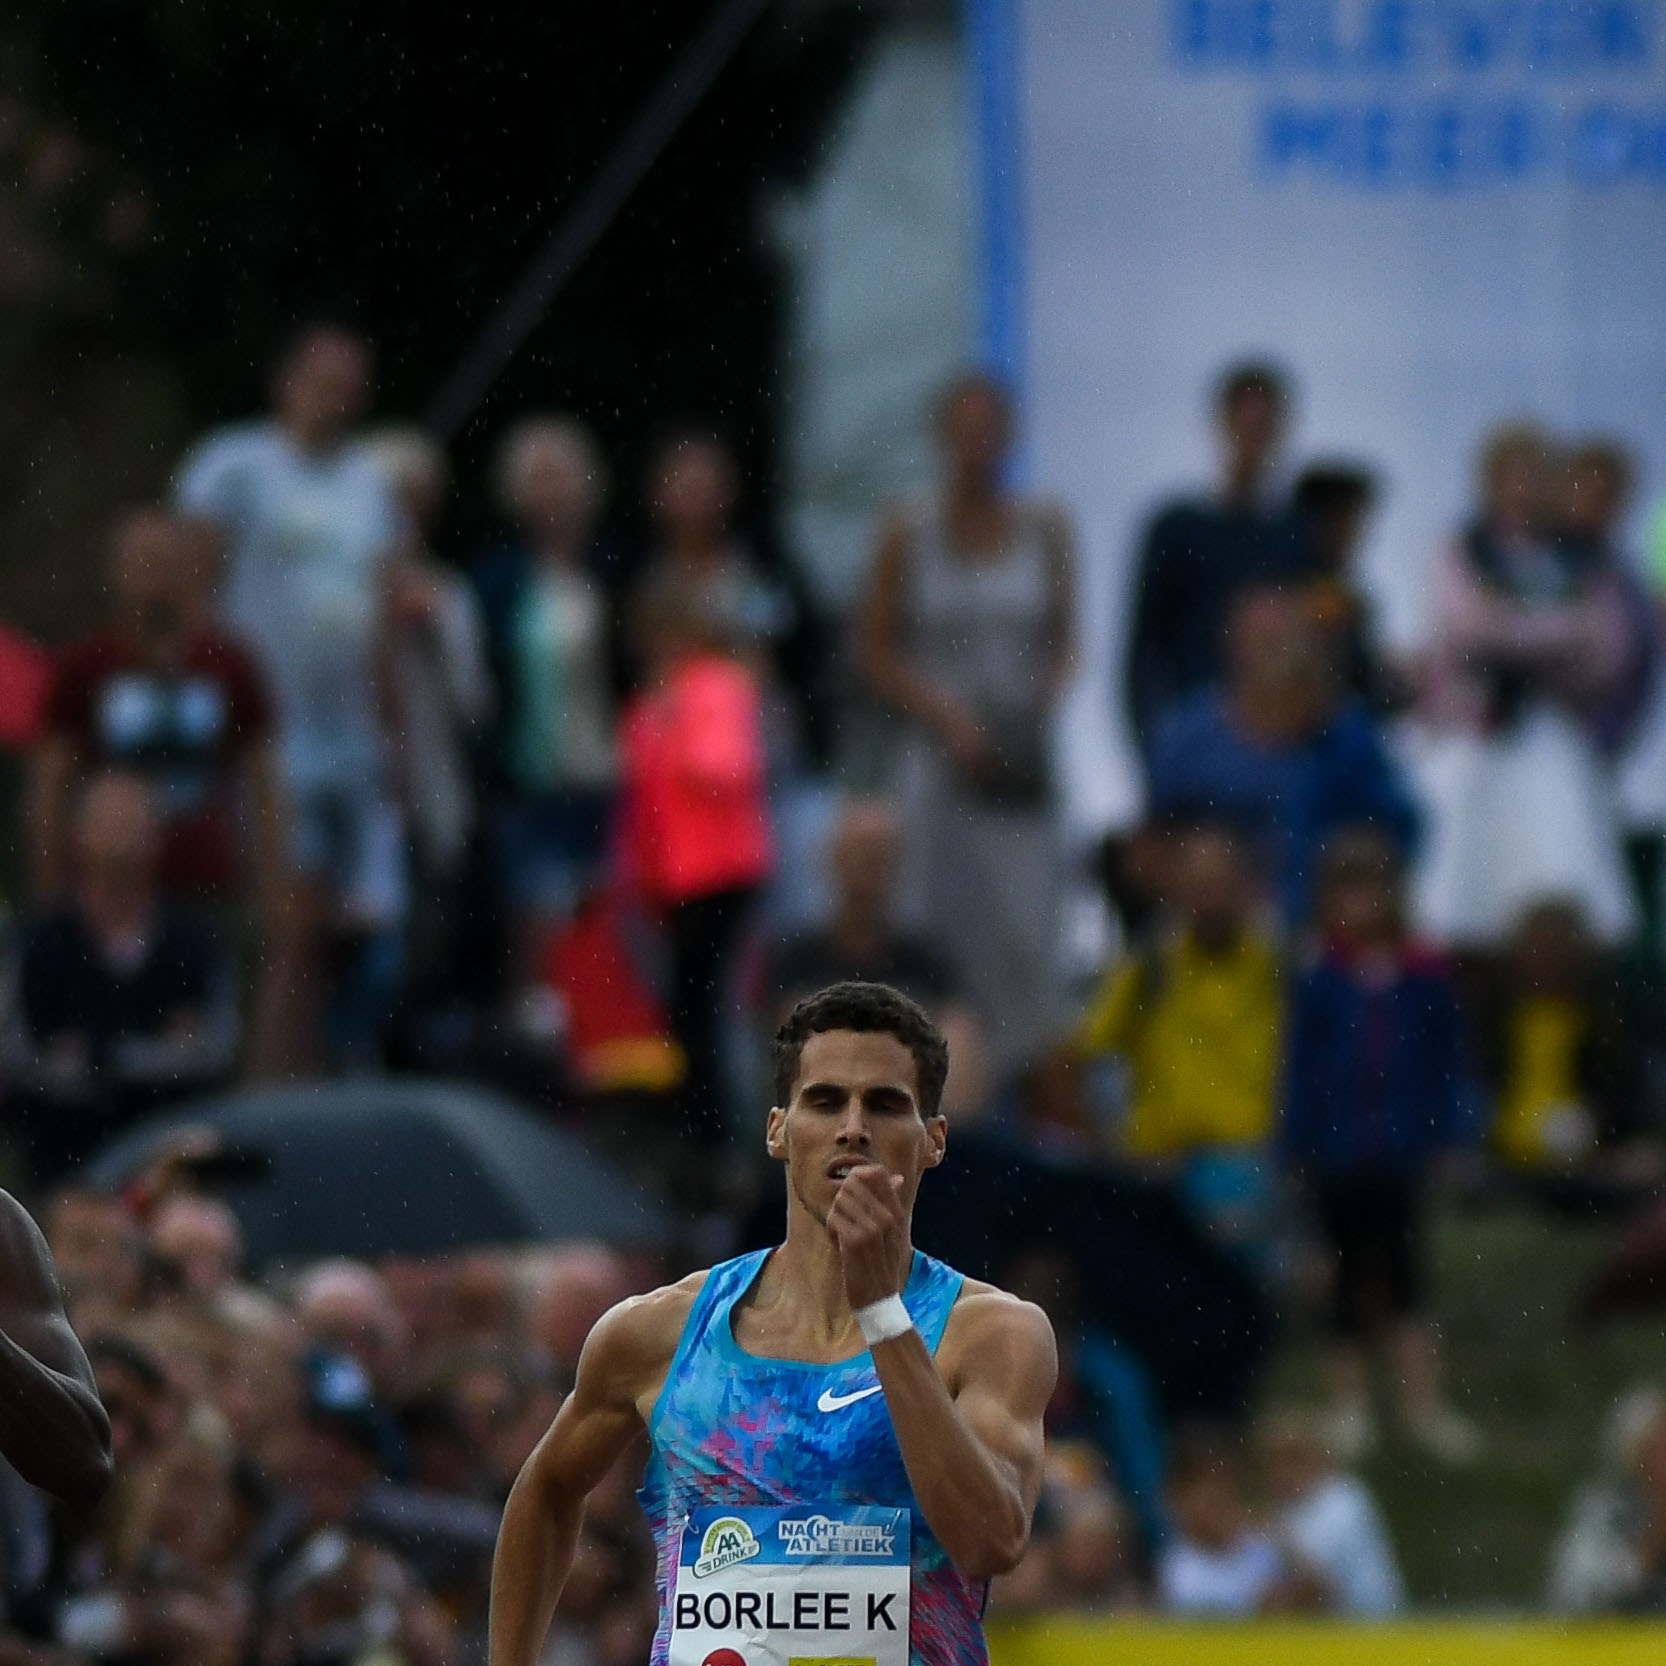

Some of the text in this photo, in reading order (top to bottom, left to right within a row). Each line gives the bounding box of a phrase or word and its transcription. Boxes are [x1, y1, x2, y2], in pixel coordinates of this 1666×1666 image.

[717, 1532, 740, 1555] AA
[789, 1538, 888, 1553] ATLETIEK
[713, 1548, 748, 1569] DRINK
[676, 1592, 897, 1630] BORLEE K
